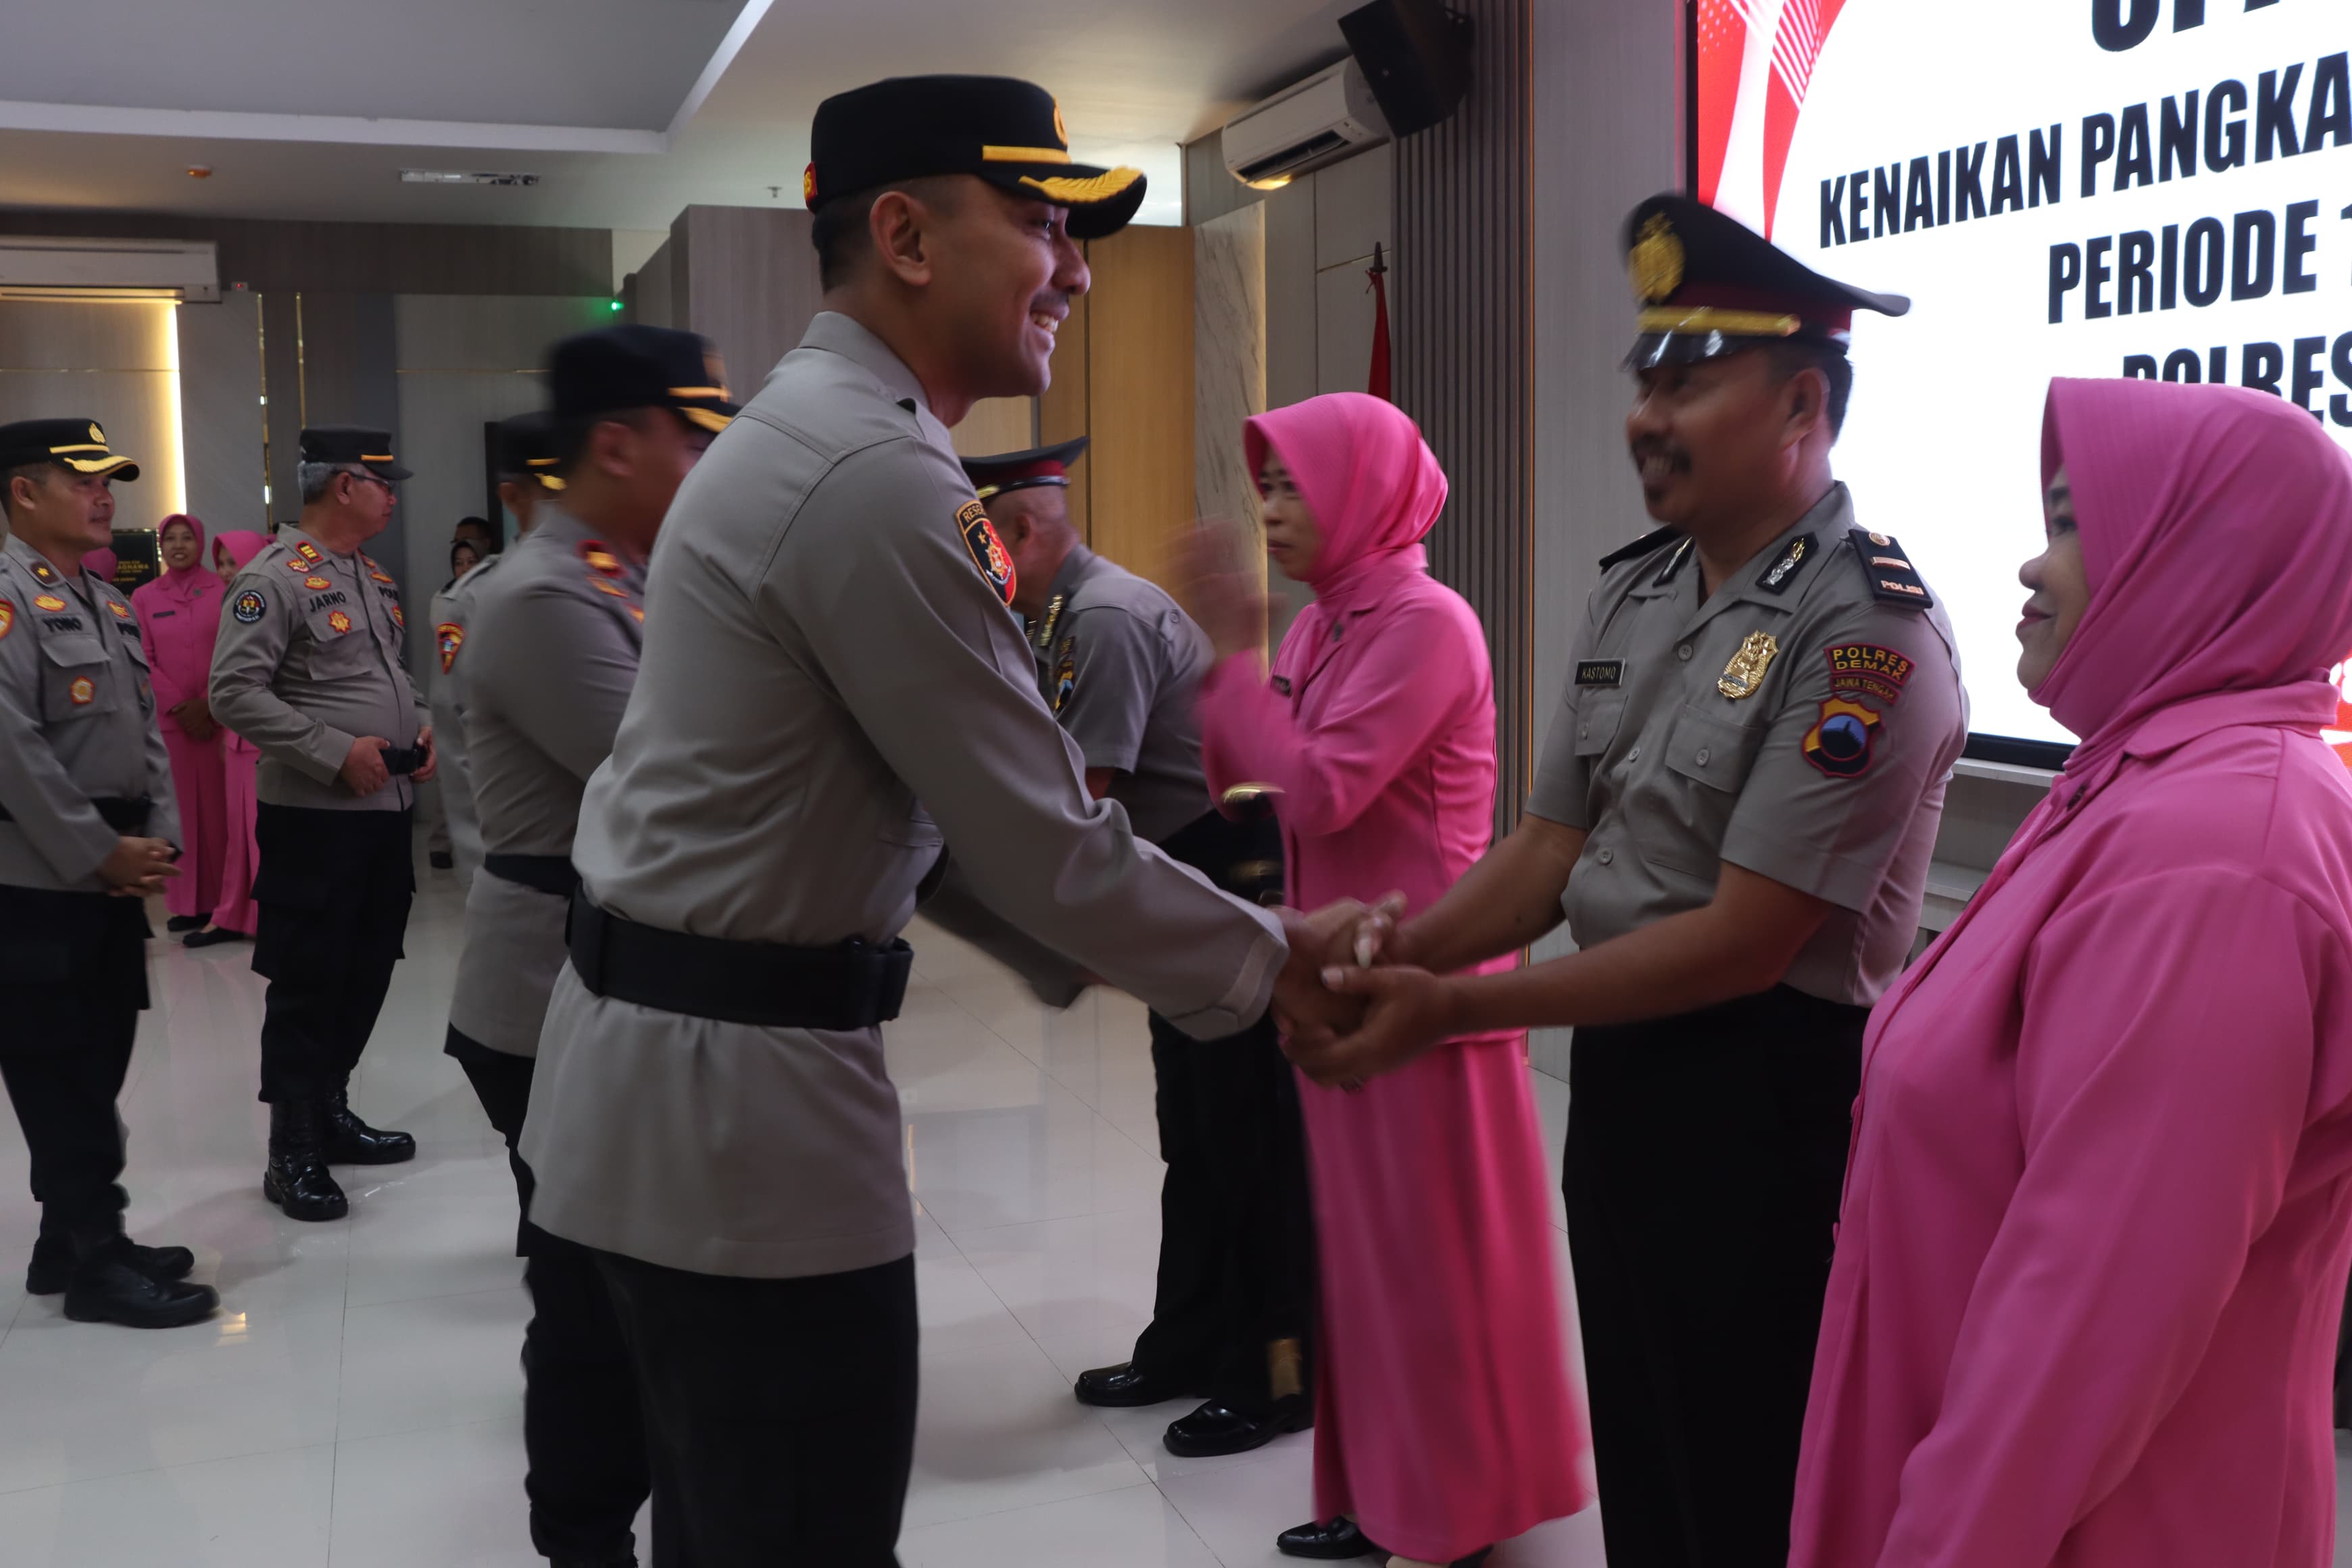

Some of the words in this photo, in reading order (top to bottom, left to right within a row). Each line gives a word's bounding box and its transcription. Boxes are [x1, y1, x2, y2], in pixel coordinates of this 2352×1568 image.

[1820, 122, 2062, 249] KENAIKAN
[2048, 199, 2319, 324] PERIODE
[2123, 330, 2352, 427] RES
[1880, 579, 1924, 595] POLISI
[310, 591, 346, 612] JARNO
[1832, 646, 1909, 672] POLRES
[1836, 658, 1903, 681] DEMAK
[1834, 677, 1859, 688] JAWA
[1863, 678, 1895, 700] TENGAH
